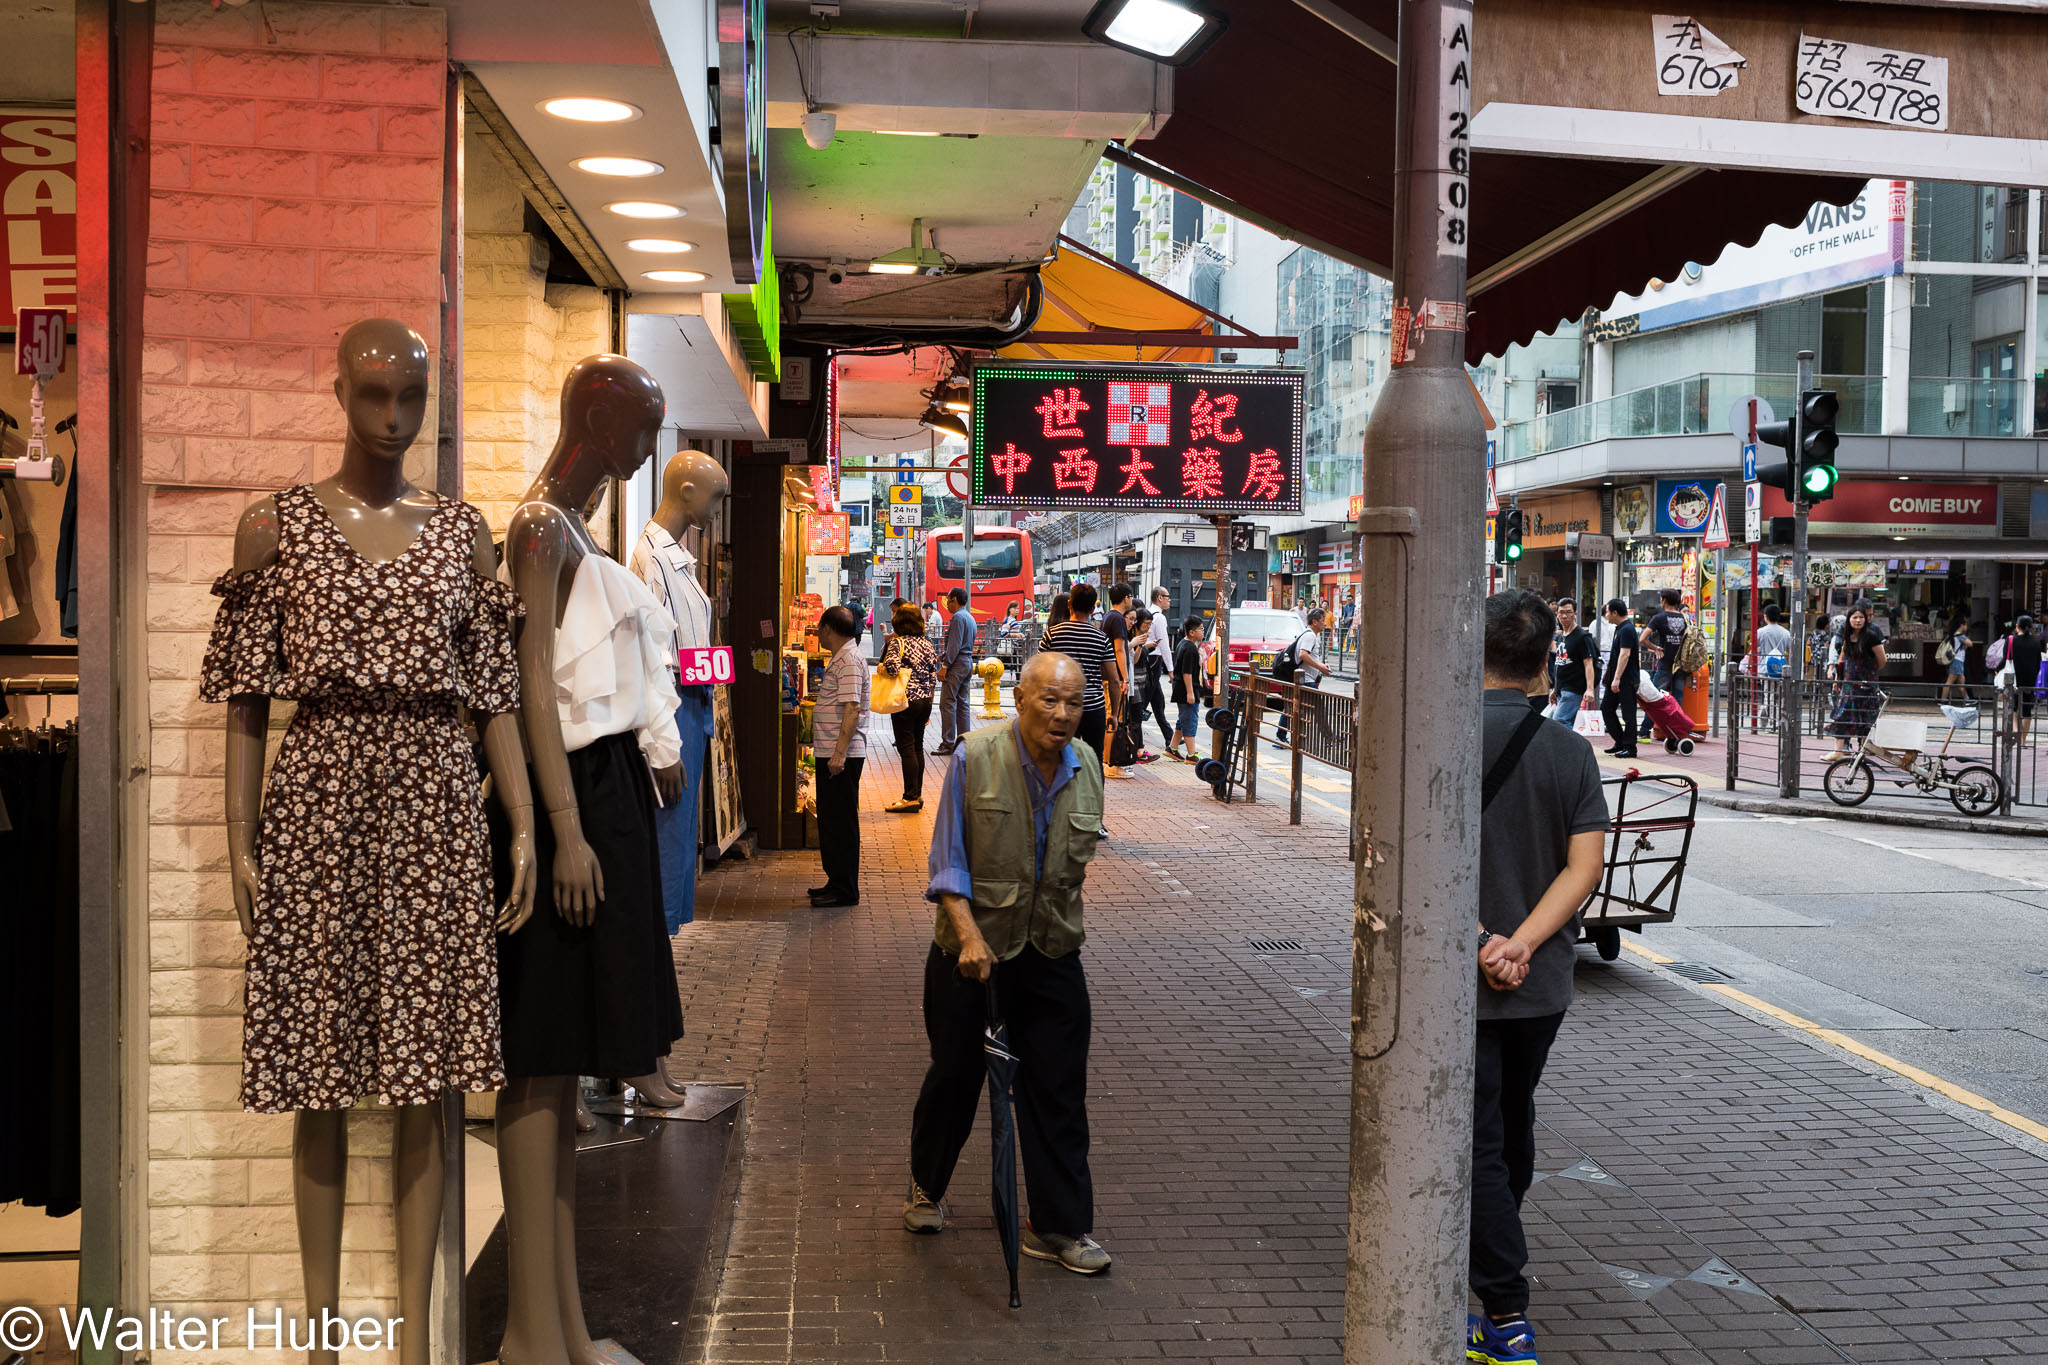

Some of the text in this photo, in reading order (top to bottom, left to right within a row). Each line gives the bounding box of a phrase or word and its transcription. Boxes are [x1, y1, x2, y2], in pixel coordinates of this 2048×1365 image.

[1797, 71, 1940, 125] 67629788
[1, 119, 77, 314] SALE
[1805, 194, 1866, 235] VANS
[1819, 239, 1841, 251] THE
[23, 314, 64, 369] $50
[990, 442, 1286, 501] 中西大藥房
[896, 514, 915, 524] 全日
[1889, 497, 1982, 514] COME BUY
[685, 649, 732, 682] $50
